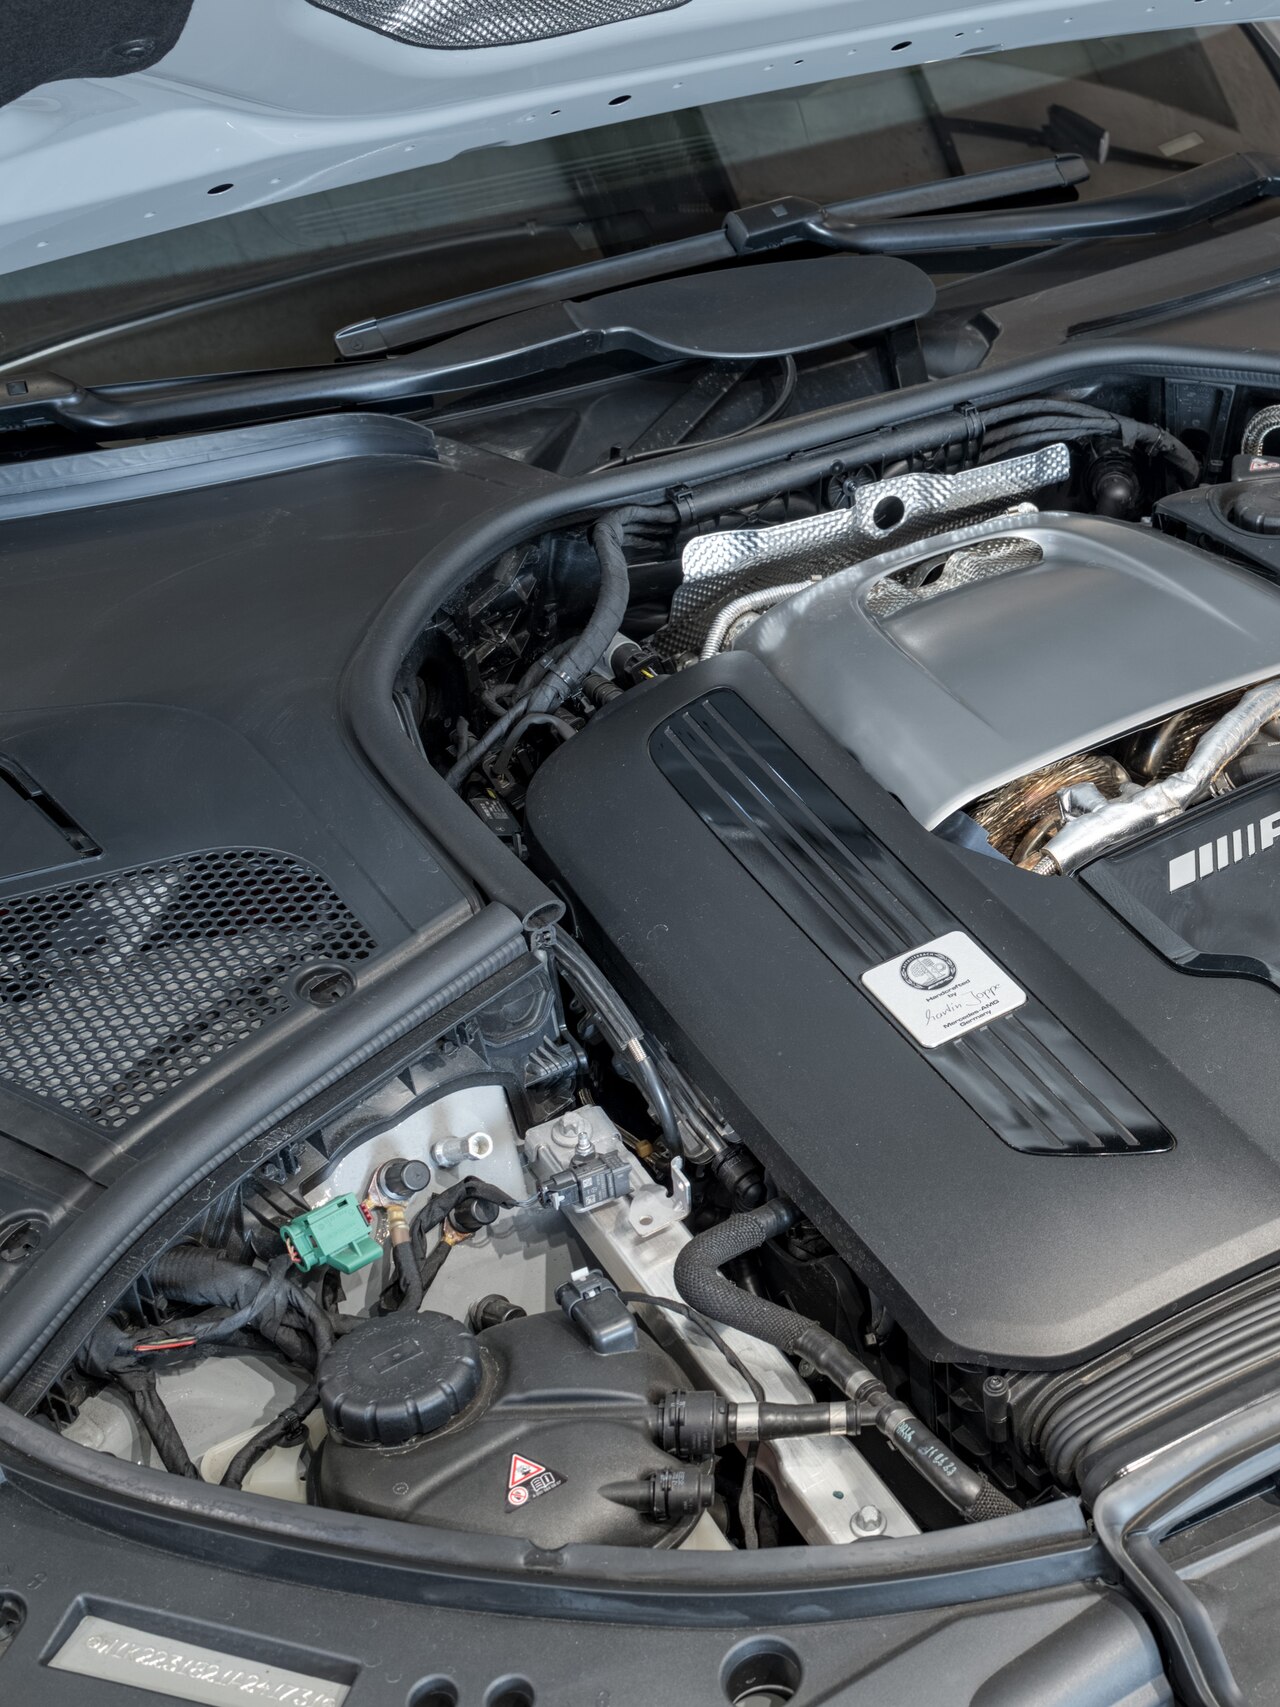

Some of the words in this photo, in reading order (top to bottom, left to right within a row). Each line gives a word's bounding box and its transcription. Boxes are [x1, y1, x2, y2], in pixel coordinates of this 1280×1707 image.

[926, 979, 970, 1002] Handcrafted
[943, 999, 1000, 1028] Mercedes-AMG
[960, 1010, 992, 1027] Germany
